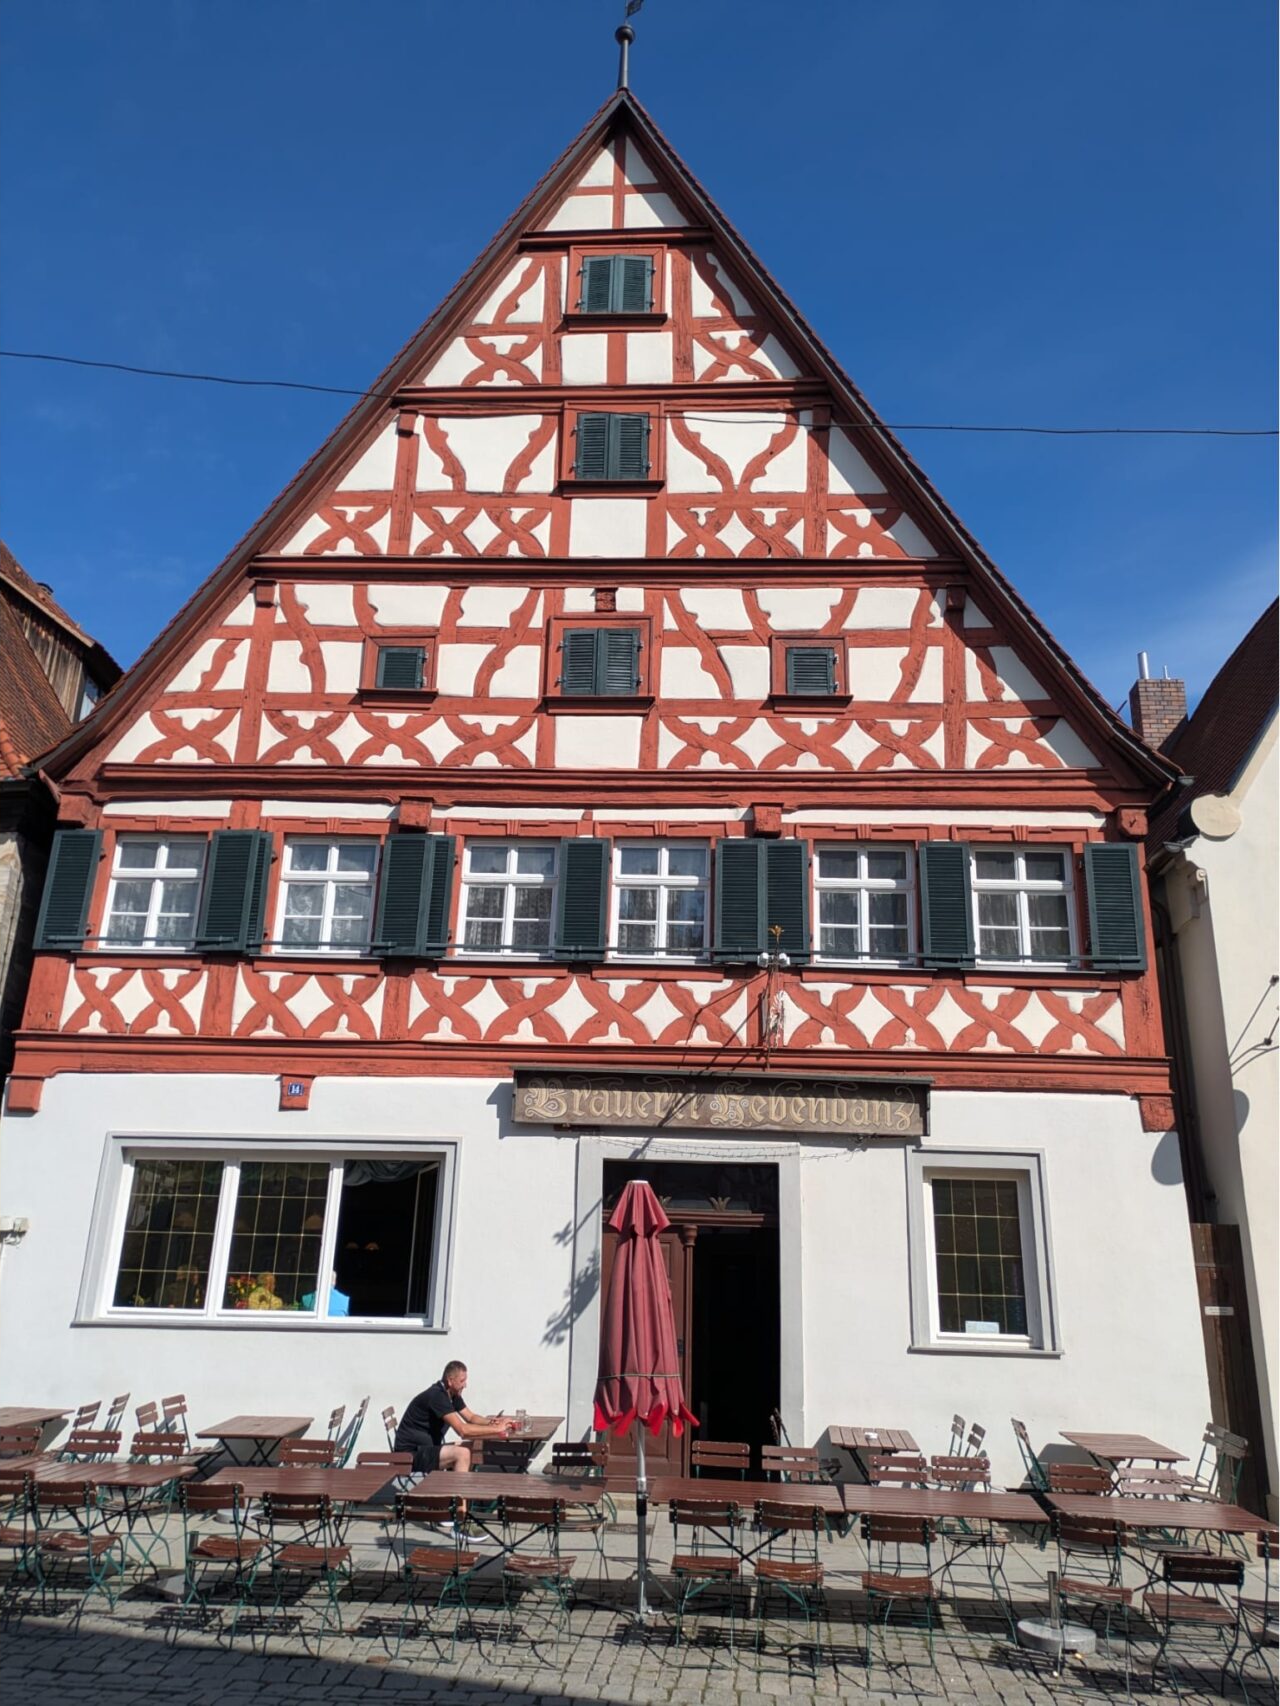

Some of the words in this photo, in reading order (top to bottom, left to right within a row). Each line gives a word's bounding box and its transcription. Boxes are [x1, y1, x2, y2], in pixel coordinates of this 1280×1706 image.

[290, 1084, 301, 1094] 14
[523, 1076, 702, 1120] Brauerei
[710, 1078, 916, 1130] Hebendanz
